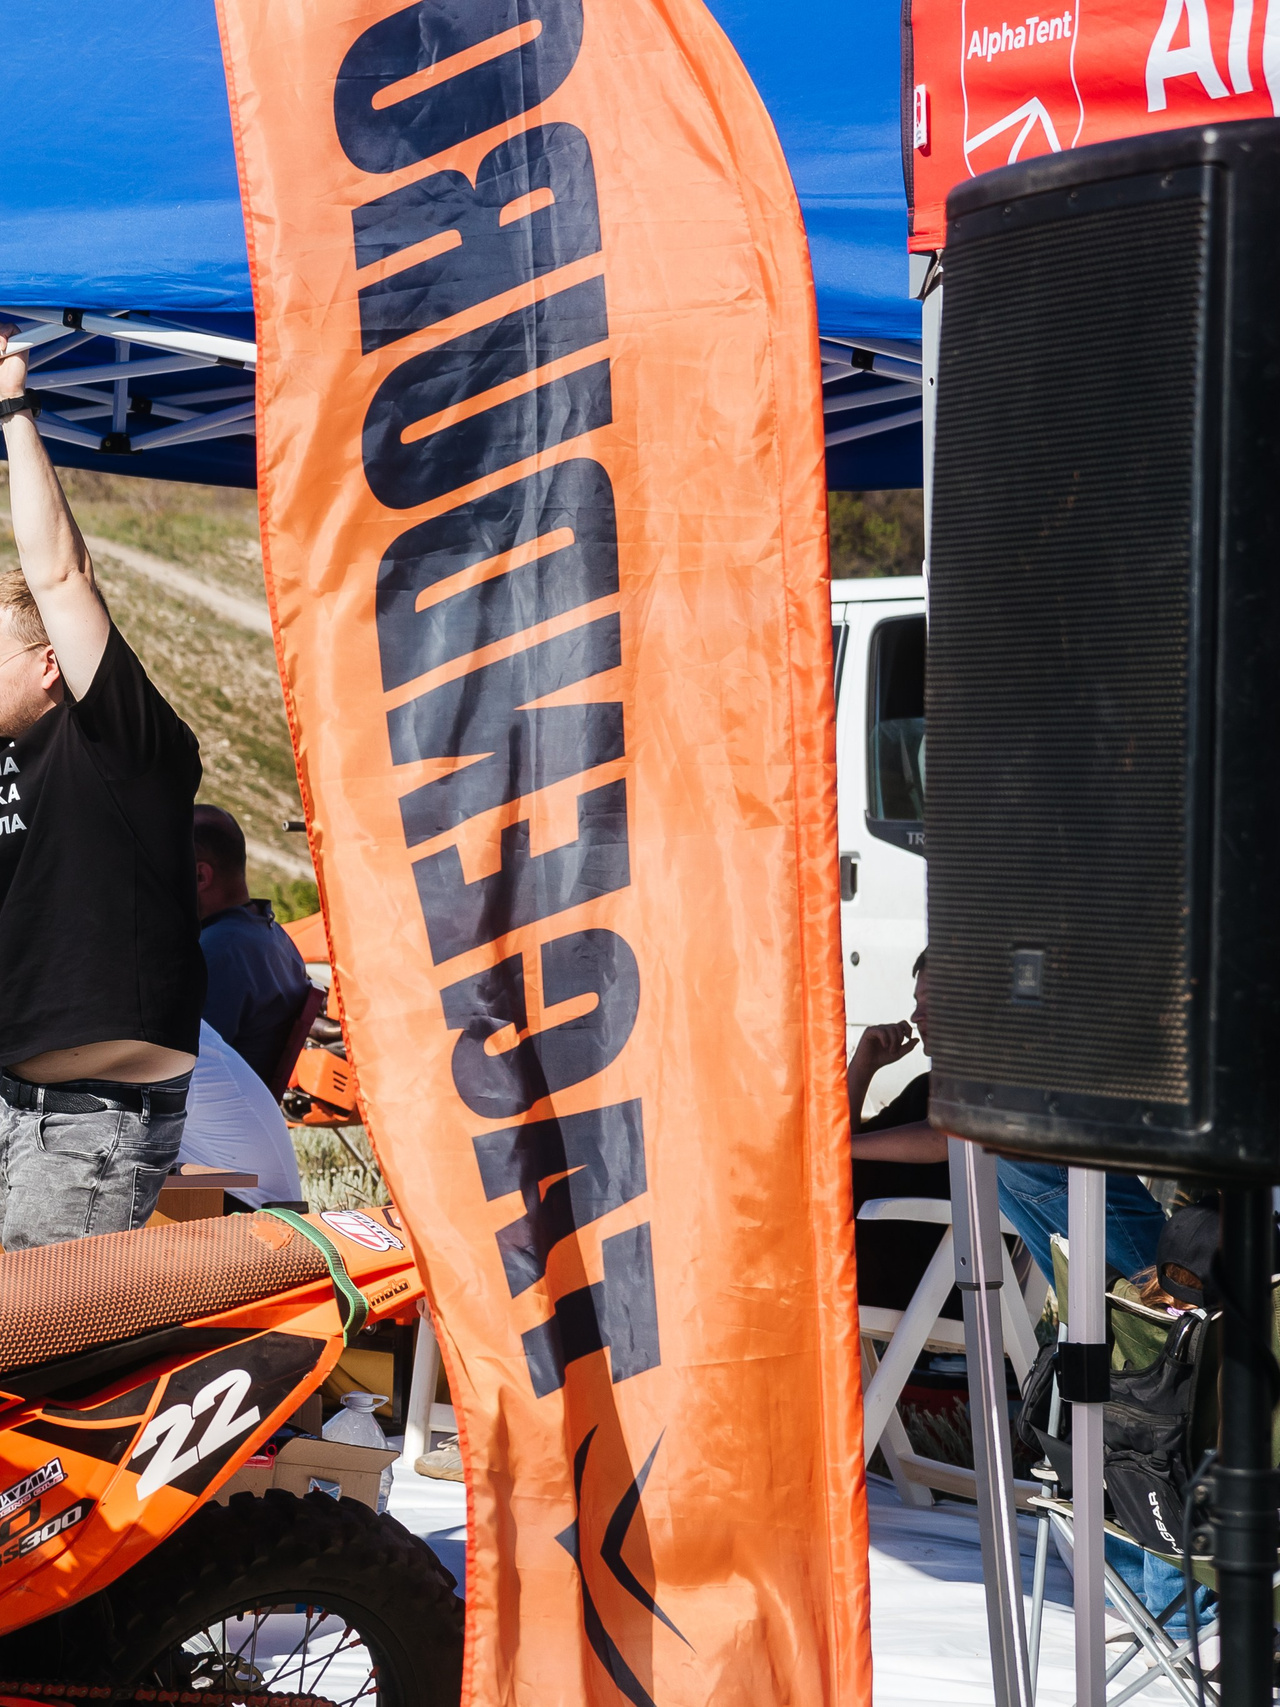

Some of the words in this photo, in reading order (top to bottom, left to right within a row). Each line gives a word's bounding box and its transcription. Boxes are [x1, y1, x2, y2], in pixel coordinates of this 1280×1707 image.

[966, 10, 1073, 62] AlphaTent
[1145, 0, 1280, 117] Al
[131, 1368, 261, 1502] 22
